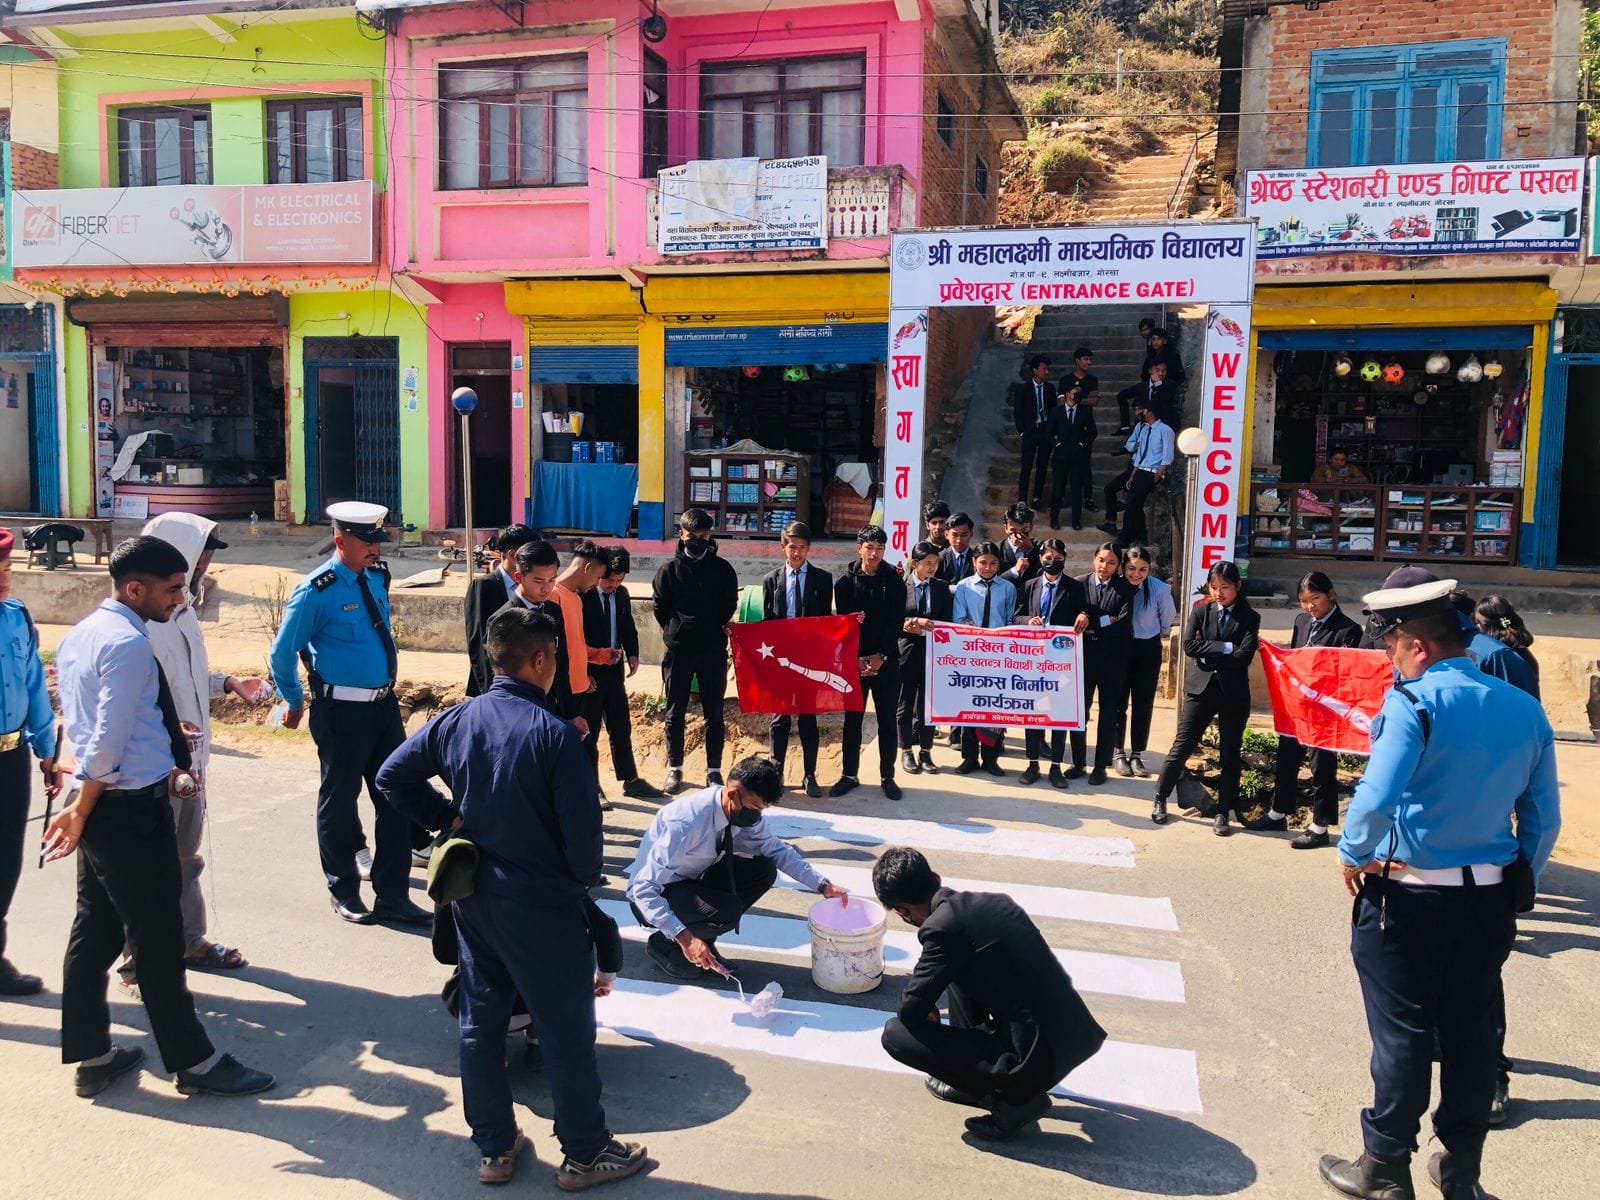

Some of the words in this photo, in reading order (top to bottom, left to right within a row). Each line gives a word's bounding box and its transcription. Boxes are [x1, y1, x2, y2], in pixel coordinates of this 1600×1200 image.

[1250, 173, 1295, 205] श्रेष्ठ
[1302, 167, 1390, 202] स्टेशनरी
[1397, 173, 1445, 198] एण्ड
[1450, 164, 1512, 196] गिफ्ट
[1519, 168, 1580, 195] पसल
[255, 195, 276, 209] MK
[280, 193, 361, 208] ELECTRICAL
[63, 214, 141, 235] FIBERNET
[253, 213, 263, 227] &
[268, 211, 362, 227] ELECTRONICS
[928, 234, 952, 266] श्री
[957, 236, 1051, 264] महालक्ष्मी
[1058, 233, 1156, 261] माध्यमिक
[1161, 231, 1246, 259] विद्यालय
[939, 278, 1014, 305] प्रवेशद्वार
[1021, 281, 1130, 301] (ENTRANCE
[1139, 278, 1195, 299] GATE)
[1200, 352, 1241, 570] WELCOME
[963, 639, 1005, 654] अखिल
[1008, 640, 1045, 656] नेपाल
[1036, 660, 1072, 674] युनियन
[948, 671, 1006, 690] जेब्राक्रस
[1011, 674, 1060, 692] निर्माण
[972, 694, 1036, 711] कार्यक्रम
